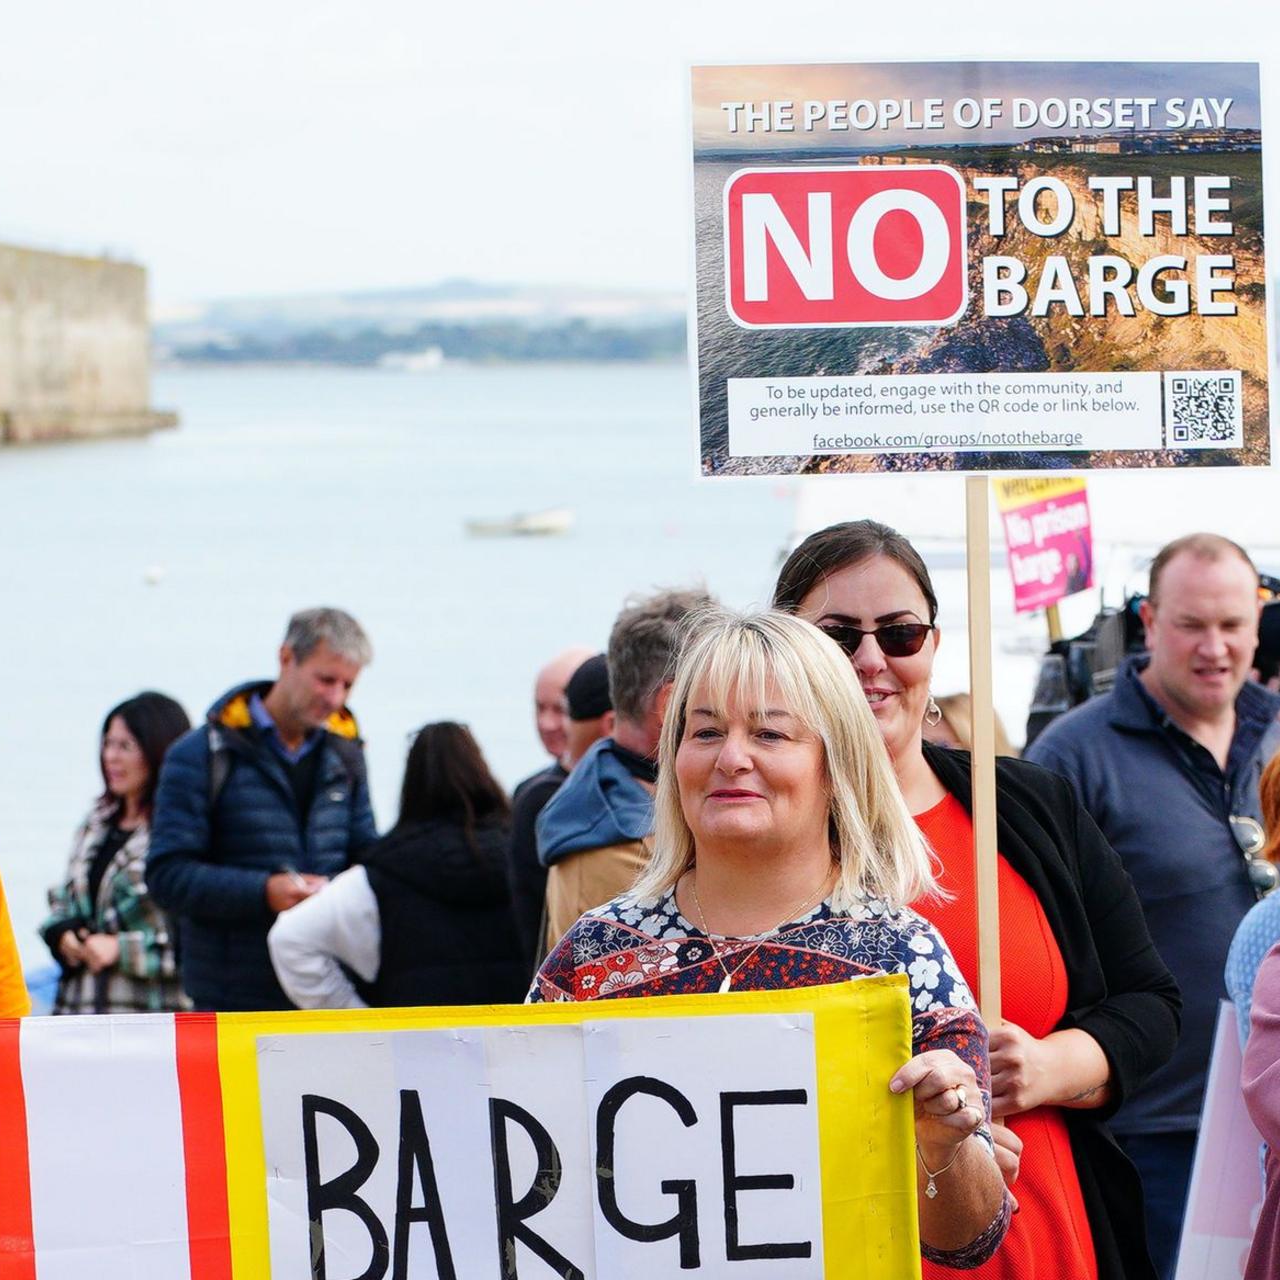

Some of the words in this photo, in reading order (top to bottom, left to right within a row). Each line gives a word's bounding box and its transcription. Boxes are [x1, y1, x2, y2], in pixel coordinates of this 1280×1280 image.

[721, 100, 794, 132] THE
[803, 98, 945, 131] PEOPLE
[952, 97, 1003, 129] OF
[1012, 96, 1155, 131] DORSET
[1165, 96, 1234, 128] SAY
[741, 187, 951, 303] NO
[973, 175, 1076, 238] TO
[1088, 174, 1234, 237] THE
[984, 254, 1238, 319] BARGE
[766, 385, 783, 399] To
[787, 385, 806, 399] be
[810, 384, 877, 401] updated,
[880, 385, 937, 400] engage
[941, 381, 973, 395] with
[977, 381, 1001, 395] the
[1004, 381, 1091, 398] community,
[1095, 381, 1123, 394] and
[750, 402, 819, 421] generally
[822, 402, 841, 416] be
[845, 401, 917, 416] informed,
[920, 403, 946, 414] use
[950, 399, 975, 413] the
[978, 399, 1000, 414] QR
[1004, 399, 1039, 413] code
[1043, 401, 1058, 412] or
[1062, 398, 1088, 412] link
[1092, 398, 1140, 412] below.
[812, 431, 1083, 449] facebook.com/groups/notothebarge
